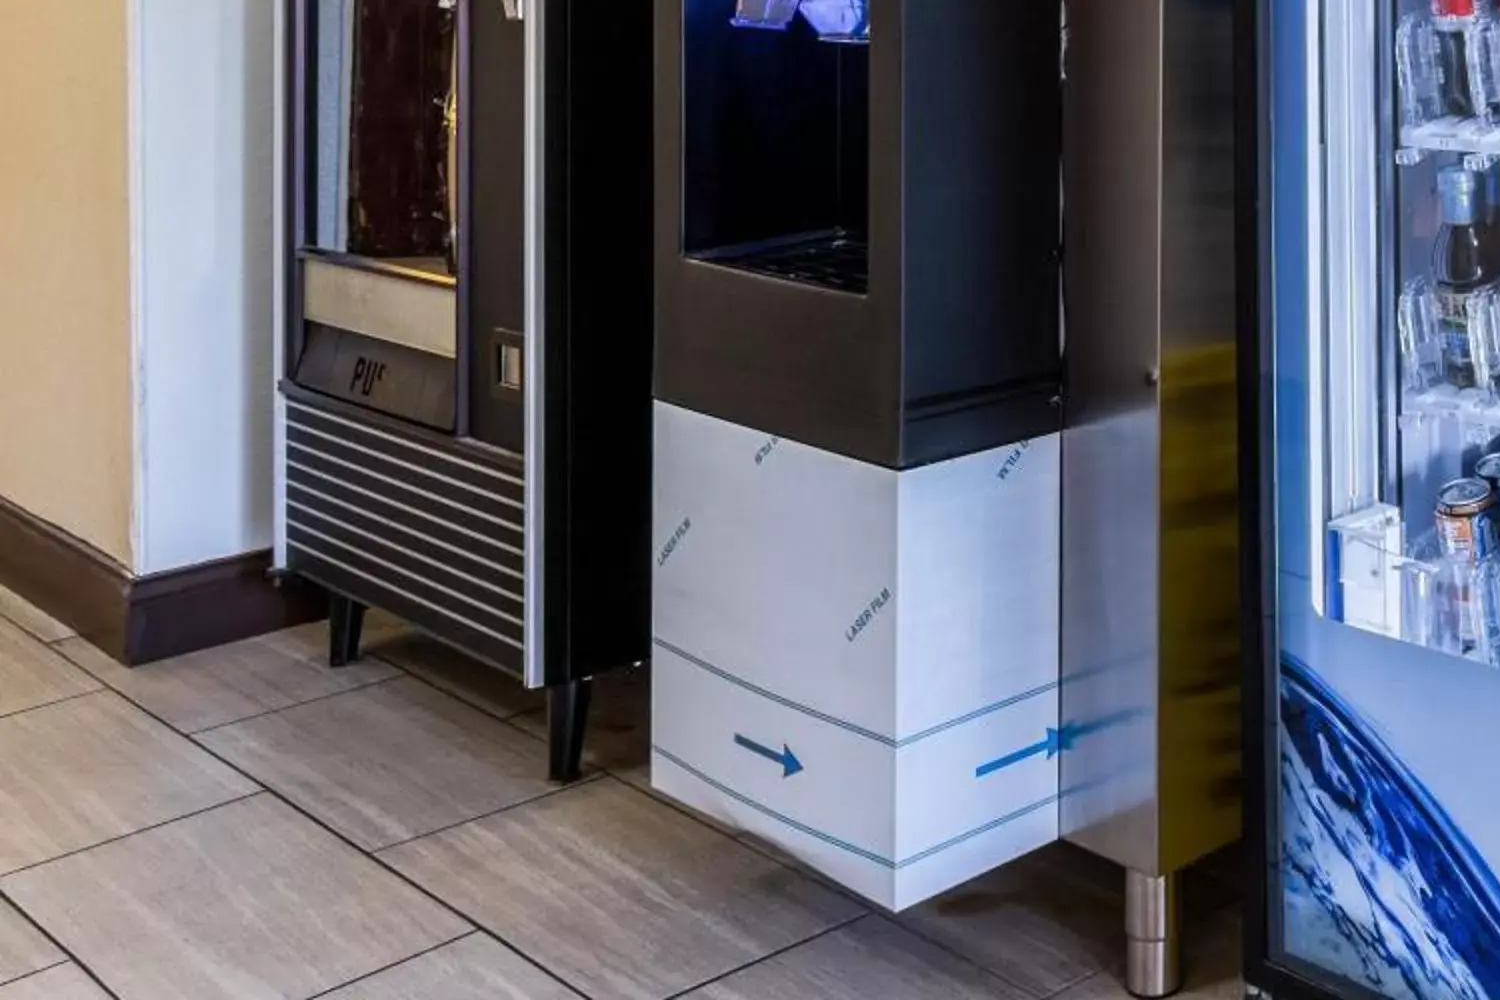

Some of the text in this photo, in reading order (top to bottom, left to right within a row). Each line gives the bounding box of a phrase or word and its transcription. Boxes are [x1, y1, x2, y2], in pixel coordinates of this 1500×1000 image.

[350, 356, 387, 396] PU
[996, 448, 1021, 480] FILM
[844, 587, 892, 643] LASER FILM
